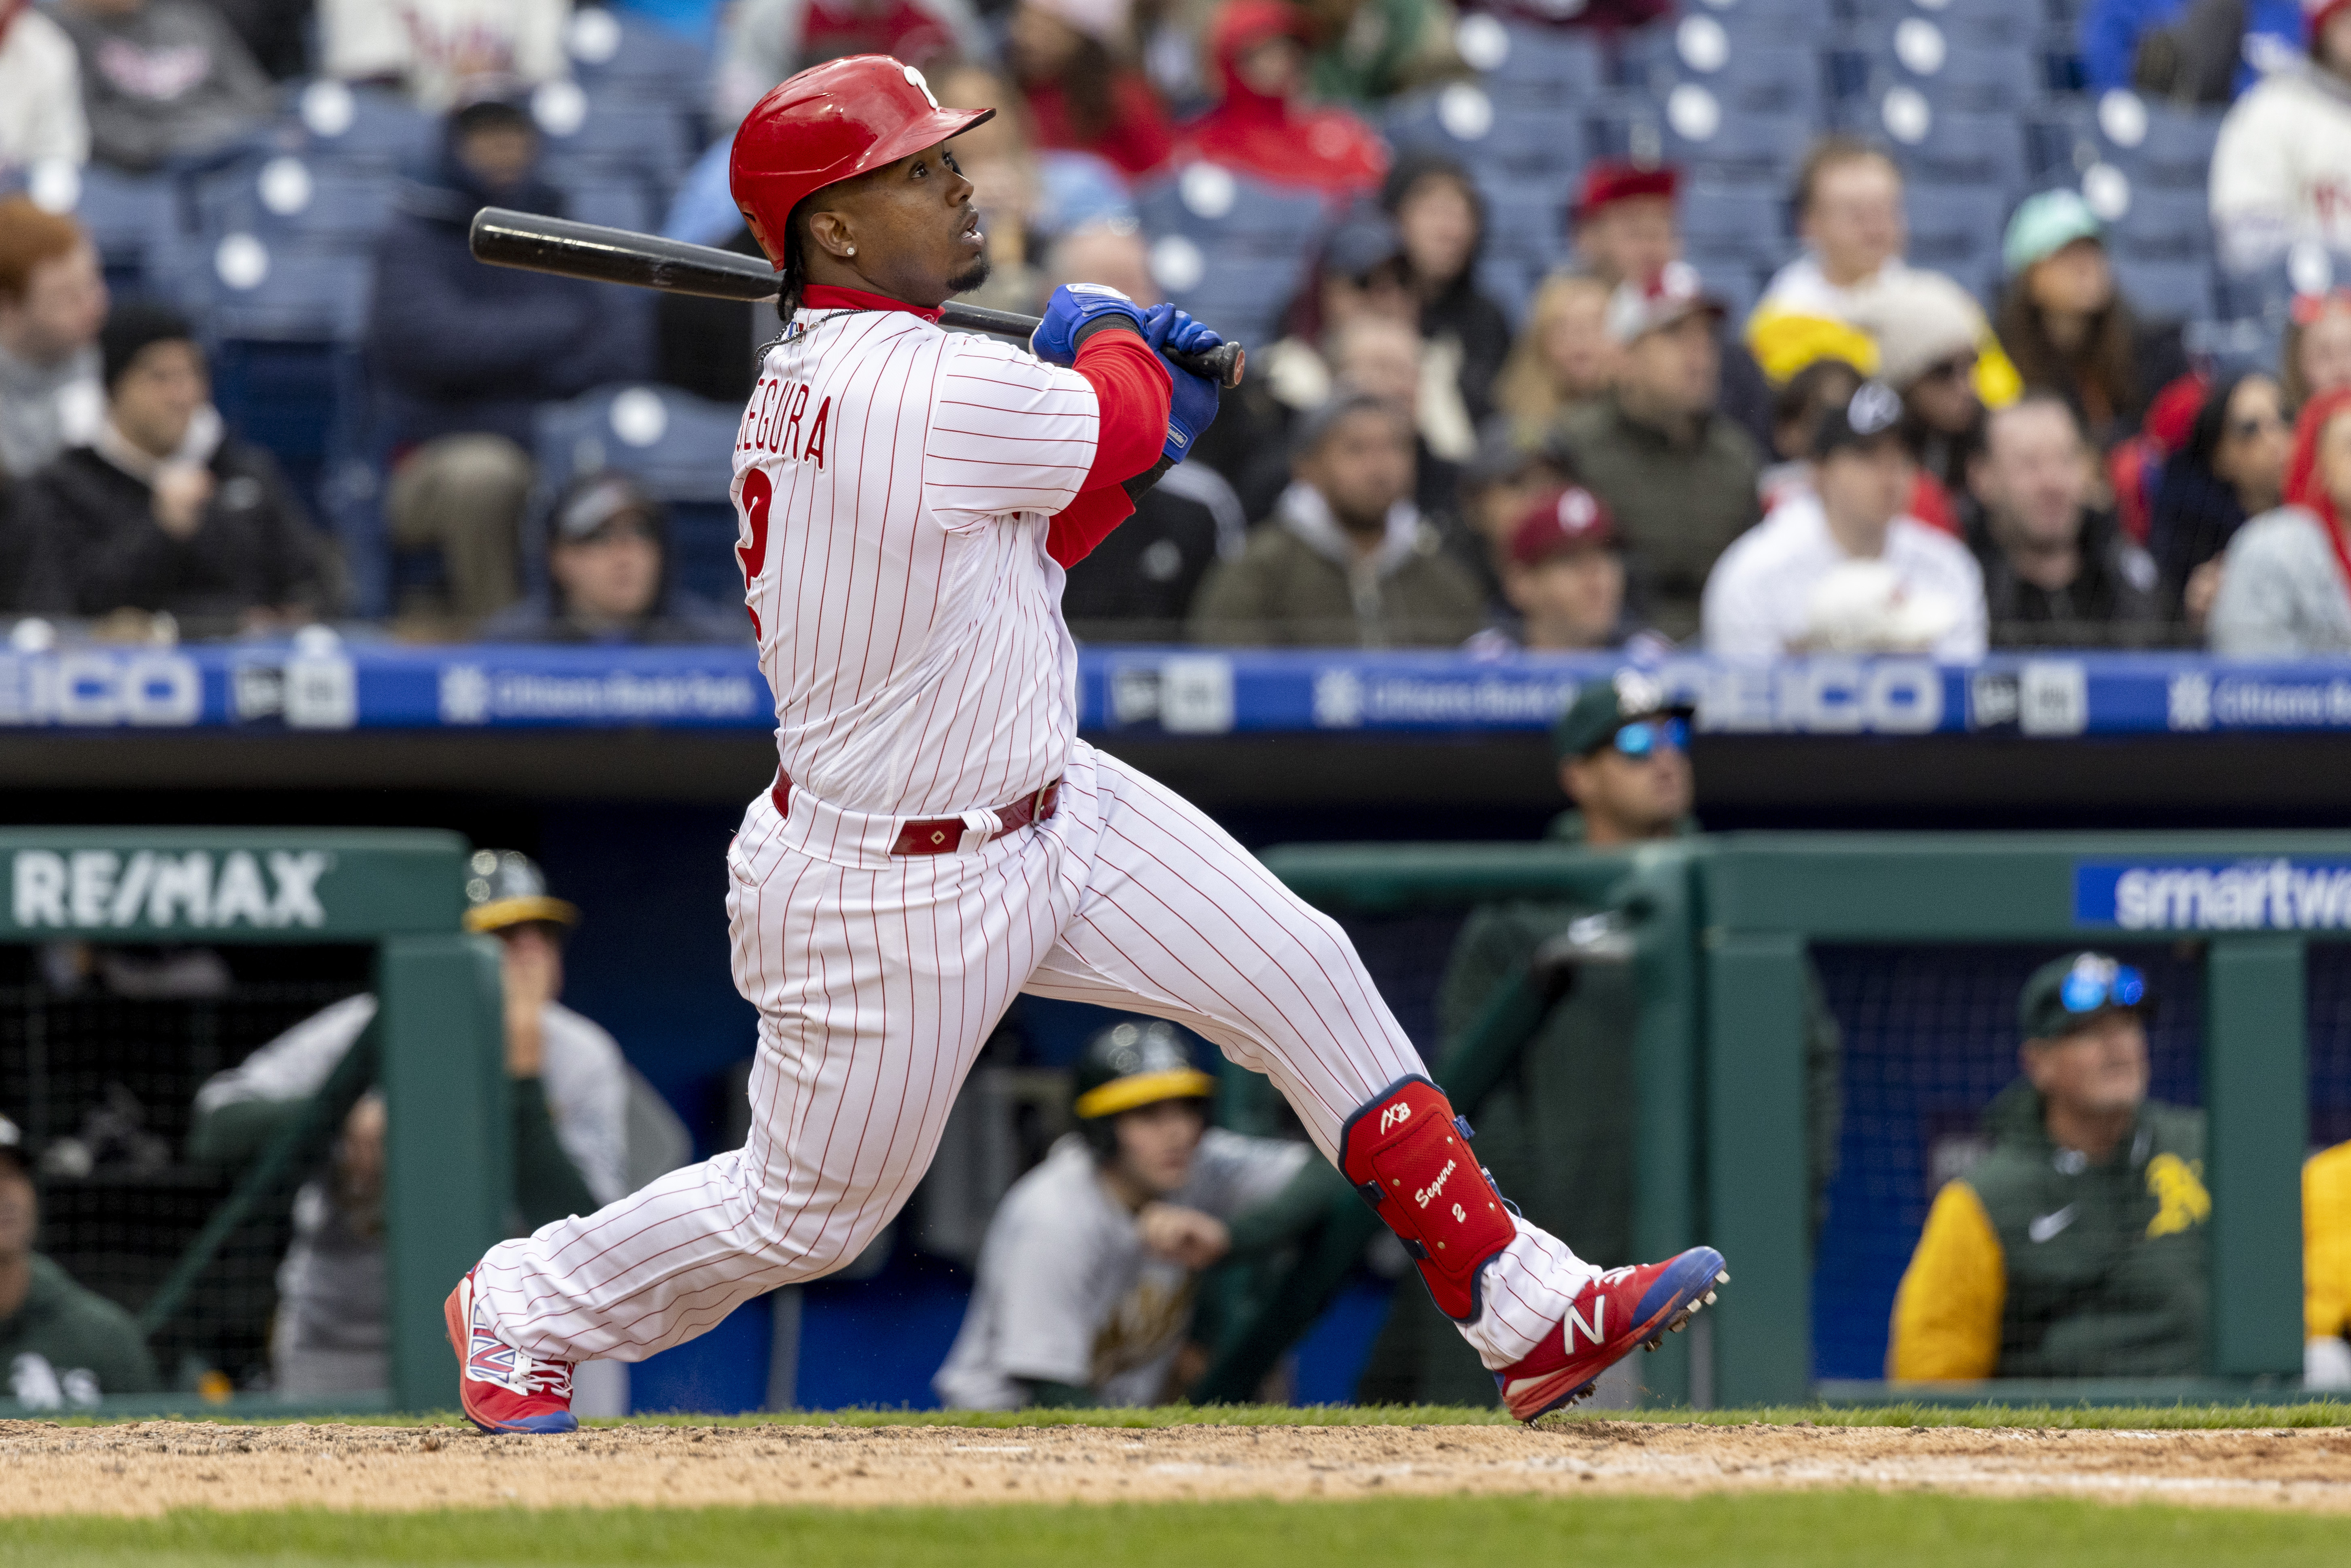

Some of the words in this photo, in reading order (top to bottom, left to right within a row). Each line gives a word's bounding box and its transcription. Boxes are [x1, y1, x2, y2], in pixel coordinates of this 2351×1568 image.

[12, 849, 325, 929] RE/MAX
[1415, 1159, 1457, 1209] Segura
[1452, 1203, 1466, 1223] 2
[1564, 1294, 1606, 1356] N
